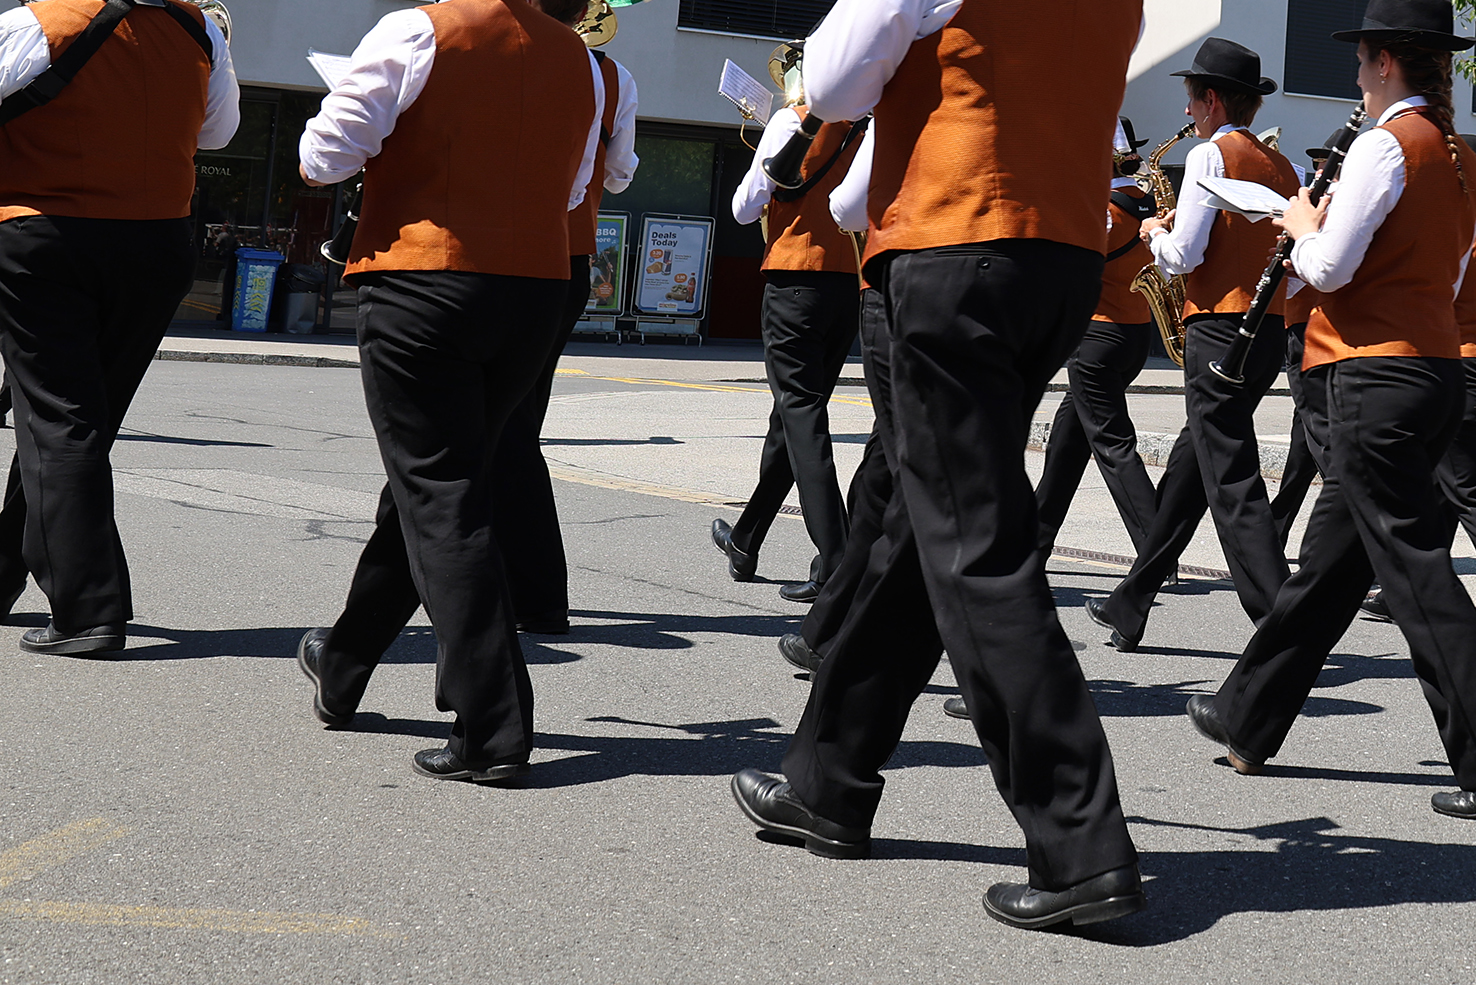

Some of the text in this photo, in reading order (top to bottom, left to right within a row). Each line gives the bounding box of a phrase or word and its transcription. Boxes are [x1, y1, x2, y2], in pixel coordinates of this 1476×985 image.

[201, 165, 232, 176] ROYAL
[596, 228, 617, 236] BBQ
[651, 231, 677, 239] Deals
[651, 239, 678, 247] Today
